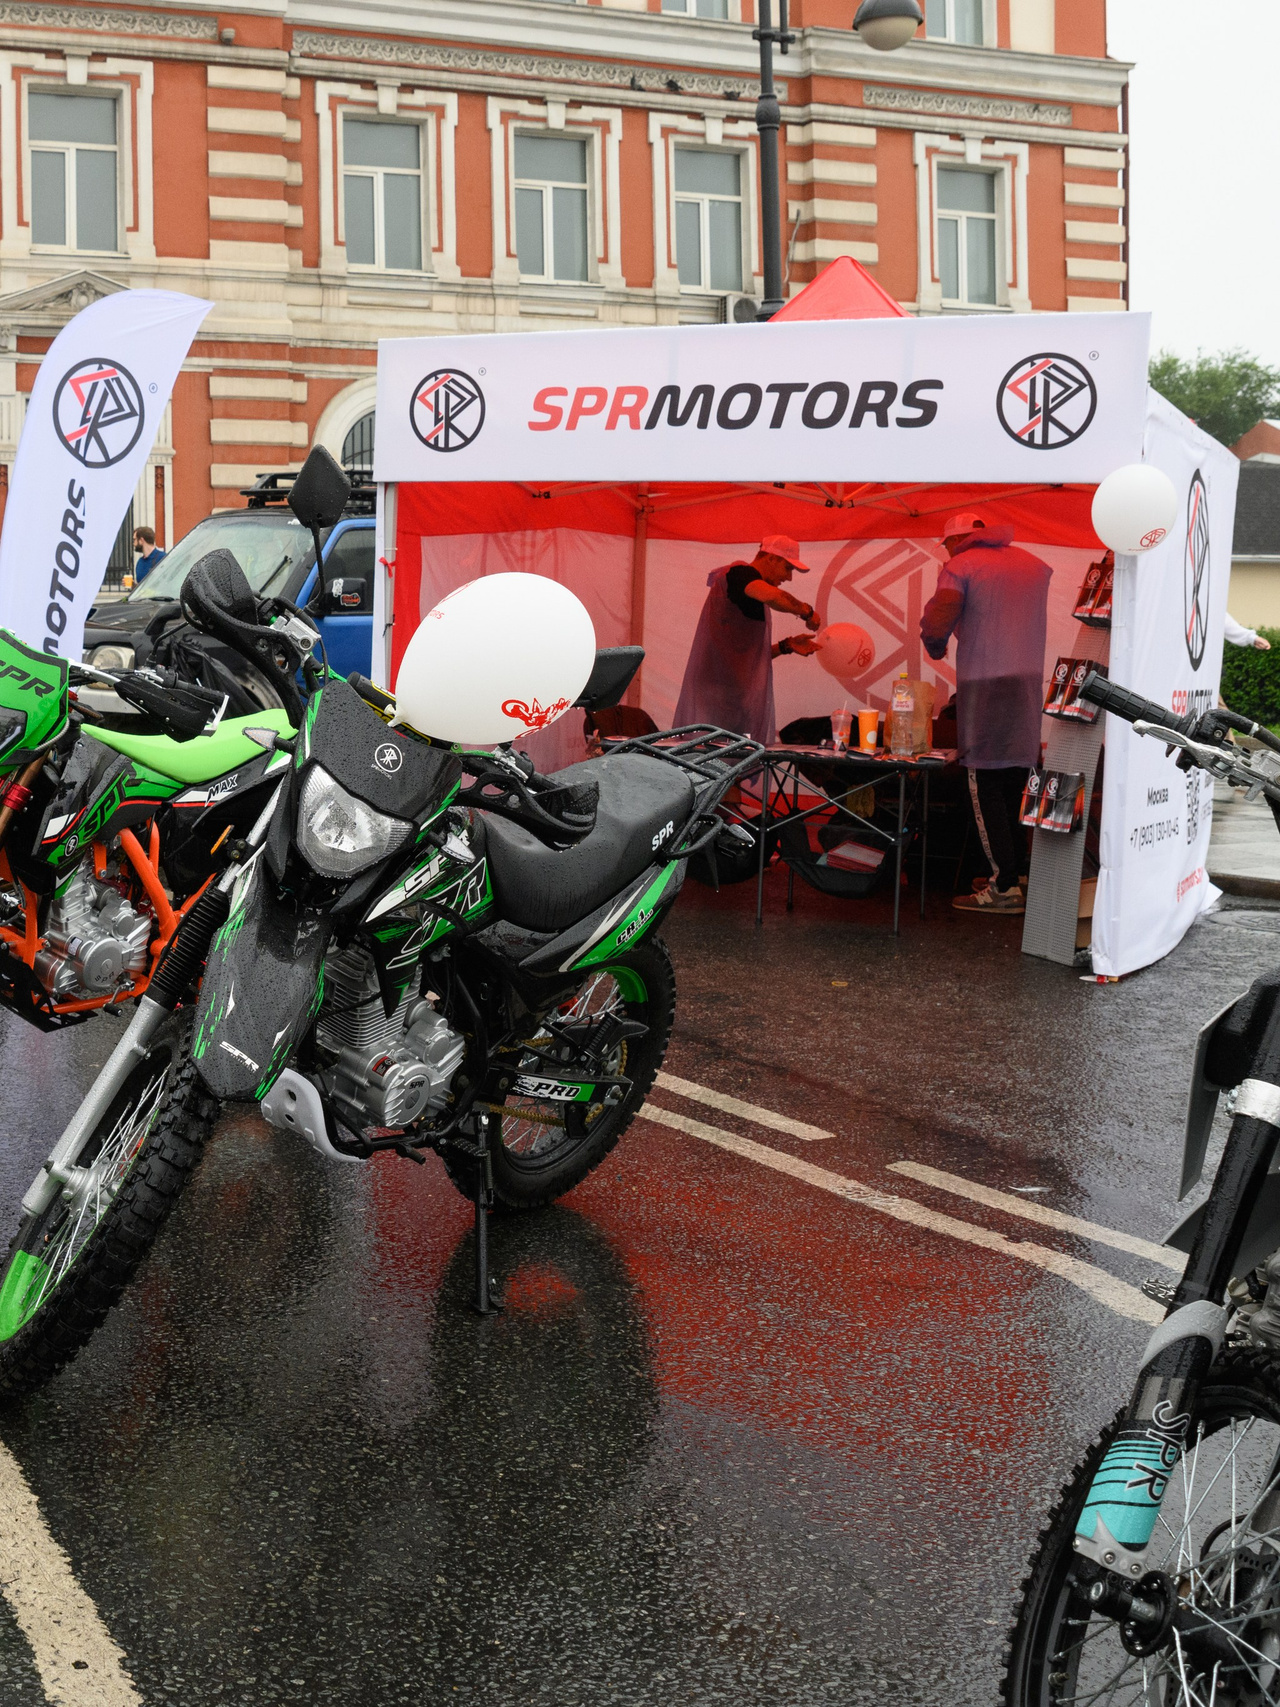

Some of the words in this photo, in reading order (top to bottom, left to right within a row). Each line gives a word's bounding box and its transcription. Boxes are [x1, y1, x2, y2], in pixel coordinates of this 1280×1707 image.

[527, 379, 945, 432] SPRMOTORS
[204, 773, 239, 808] MAX
[1146, 786, 1169, 807] Москва
[651, 820, 675, 852] SPR
[219, 1040, 260, 1072] SPR
[409, 1080, 425, 1089] SPR
[532, 1082, 581, 1098] PRO
[1124, 1399, 1192, 1502] SPR
